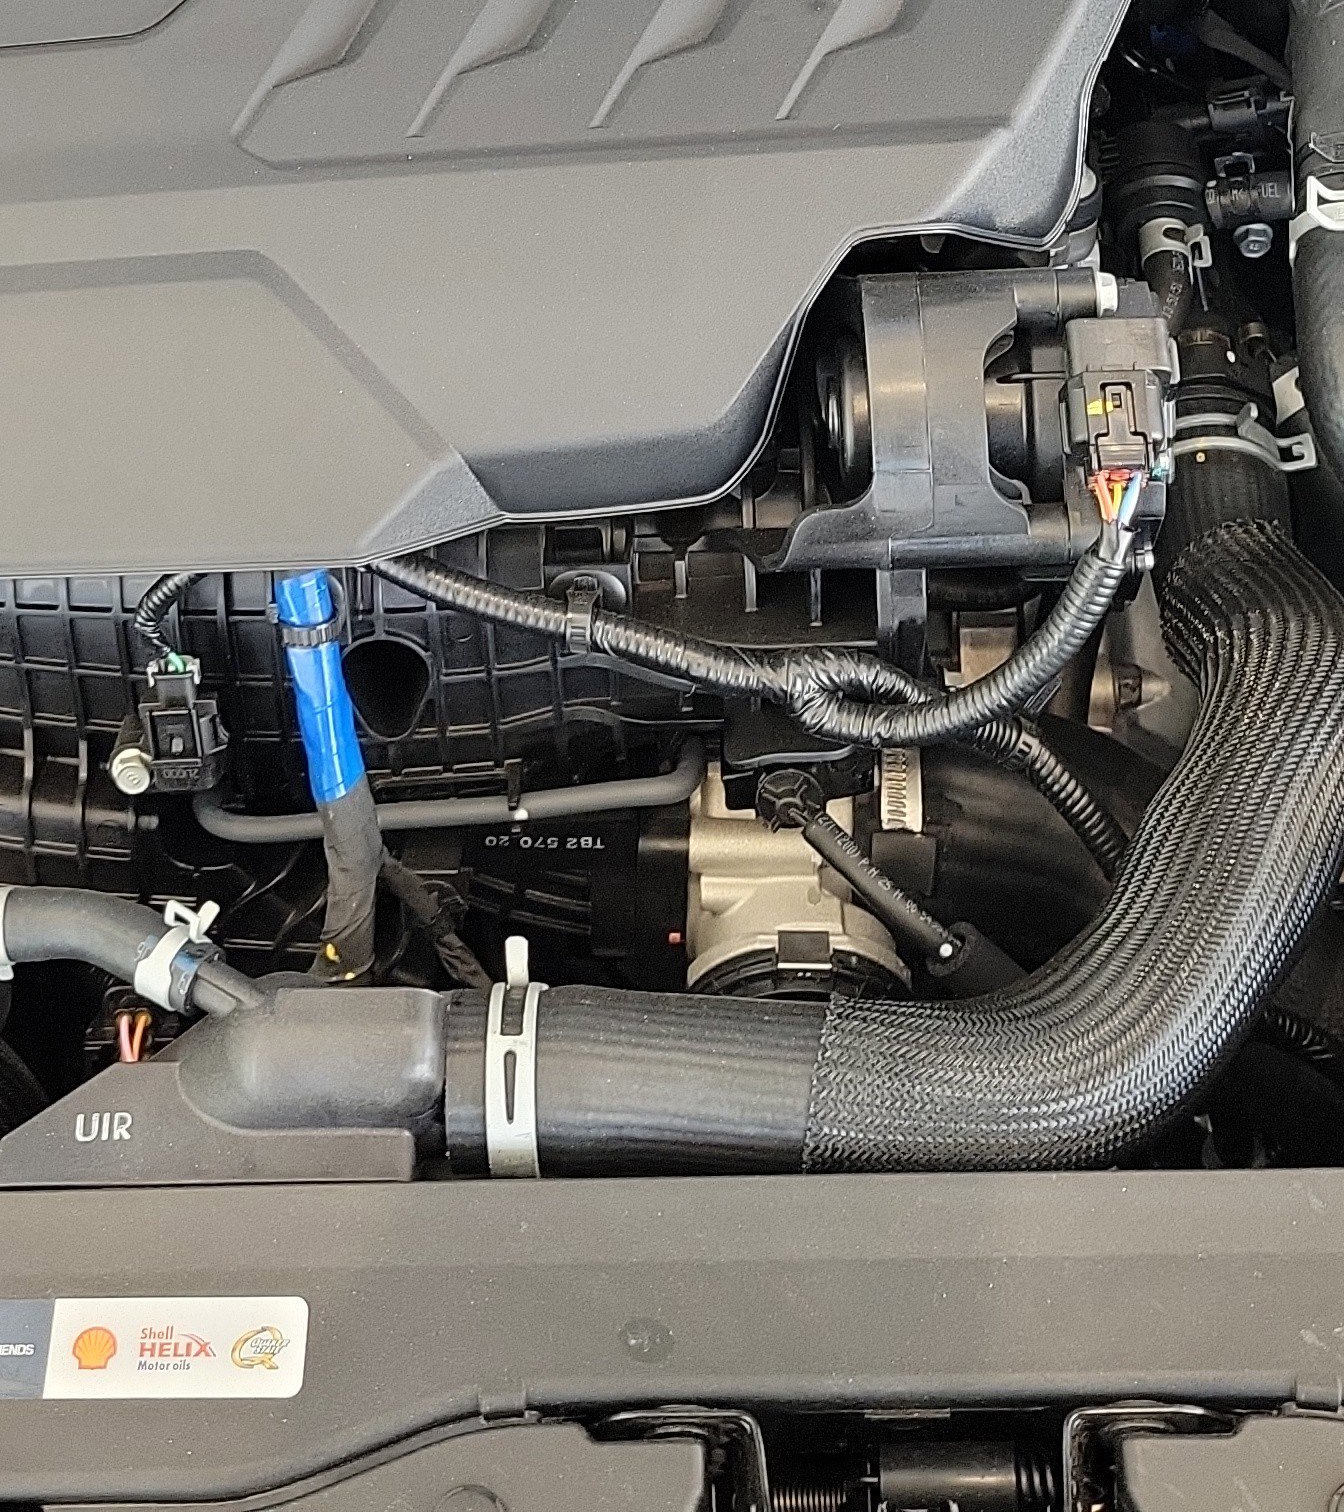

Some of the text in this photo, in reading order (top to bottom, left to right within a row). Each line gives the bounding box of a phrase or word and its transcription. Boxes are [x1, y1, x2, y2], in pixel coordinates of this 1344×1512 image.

[484, 835, 605, 849] TB2 570 20
[75, 1112, 133, 1142] UIR
[140, 1326, 174, 1340] Shell
[139, 1341, 214, 1358] HELIX
[137, 1360, 191, 1371] Motor oils
